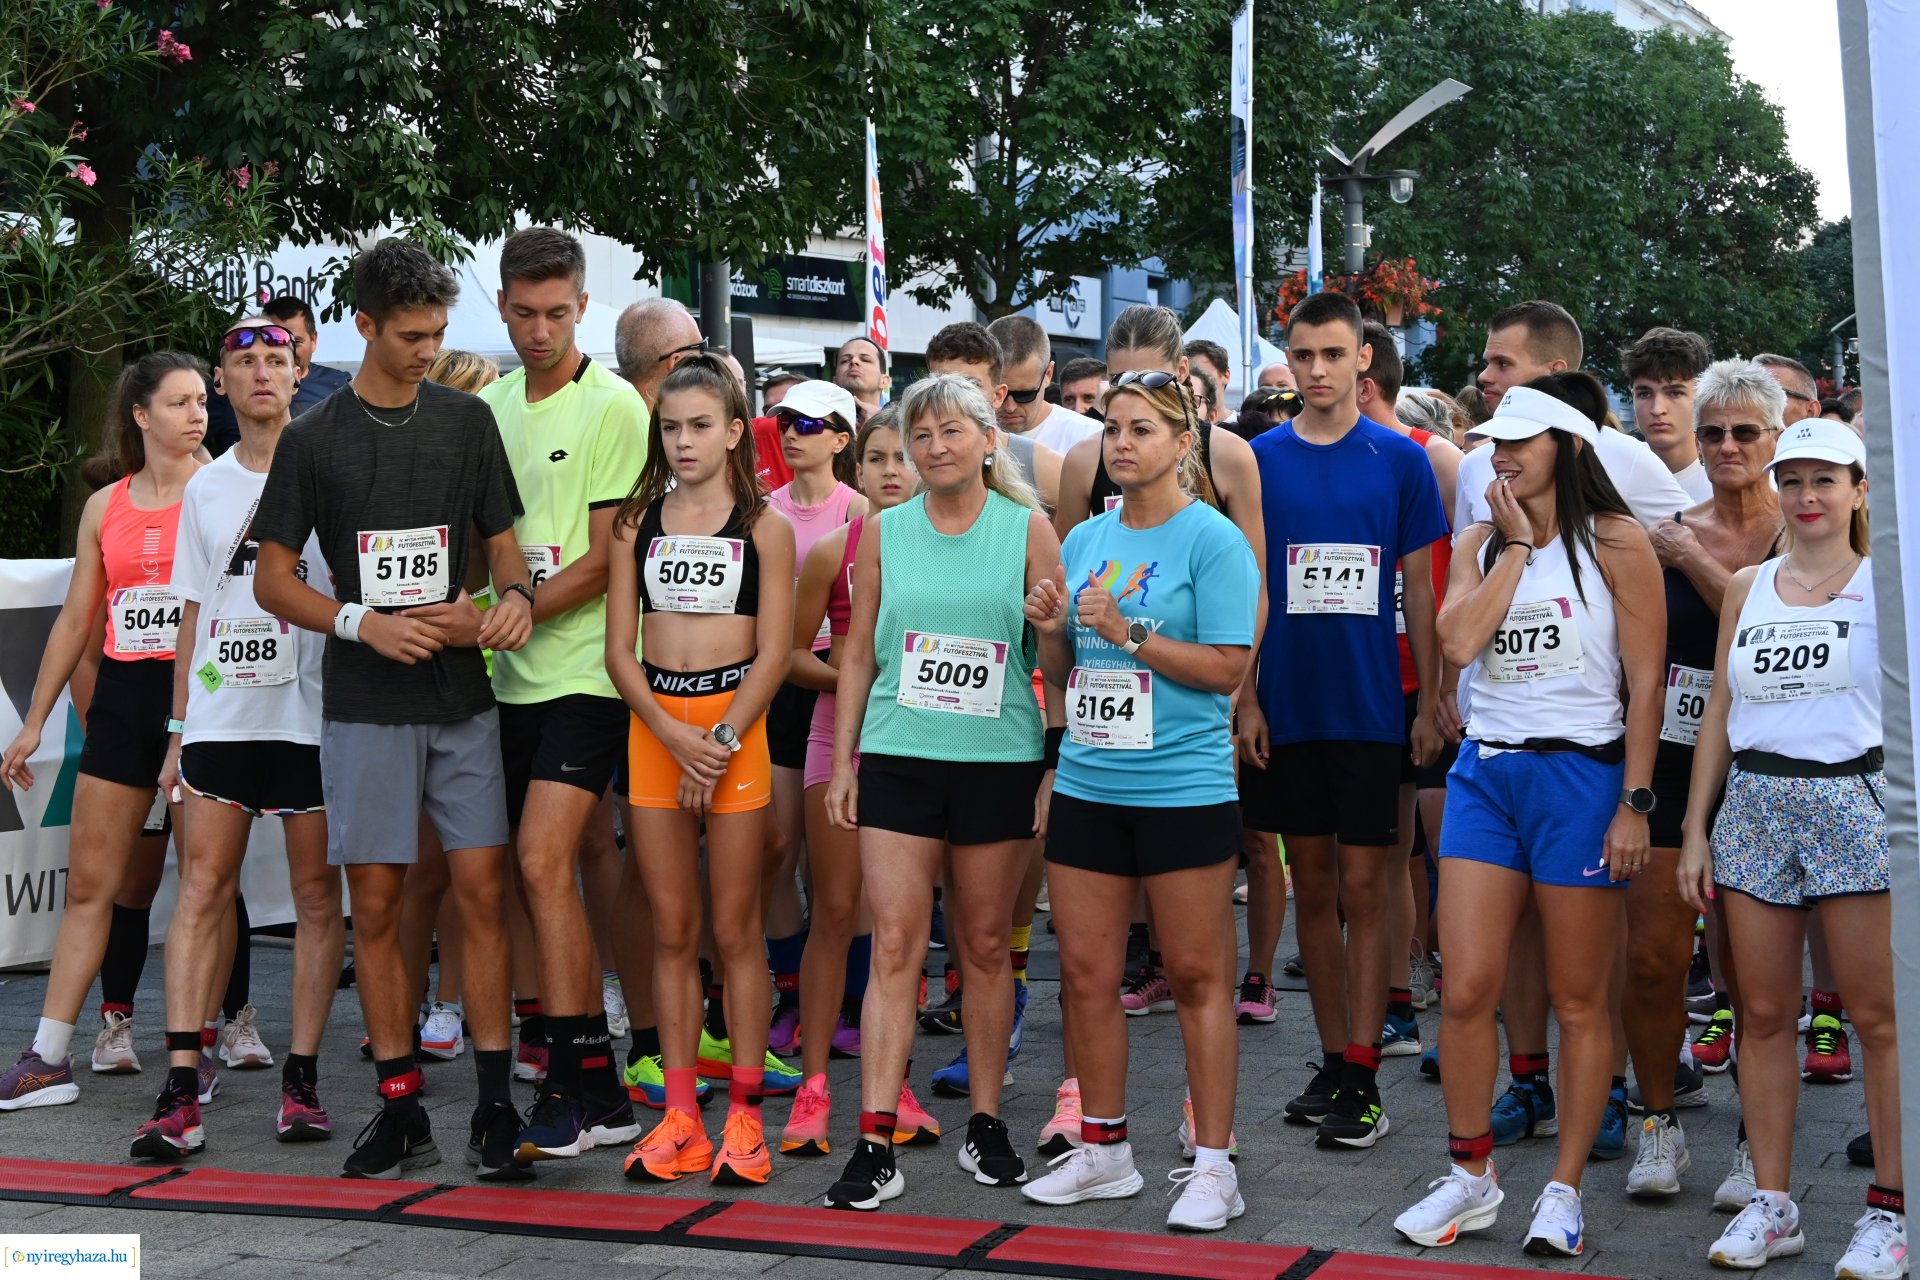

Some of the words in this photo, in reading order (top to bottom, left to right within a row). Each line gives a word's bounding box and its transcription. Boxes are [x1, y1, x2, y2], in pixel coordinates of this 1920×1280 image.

[255, 260, 319, 307] Bank
[376, 552, 438, 580] 5185
[658, 561, 727, 587] 5035
[1302, 567, 1365, 590] 5141
[124, 606, 182, 631] 5044
[218, 638, 278, 664] 5088
[1494, 624, 1561, 655] 5073
[1753, 643, 1830, 675] 5209
[653, 673, 716, 692] NIKE
[917, 659, 989, 690] 5009
[1076, 694, 1135, 722] 5164
[1676, 693, 1705, 719] 50
